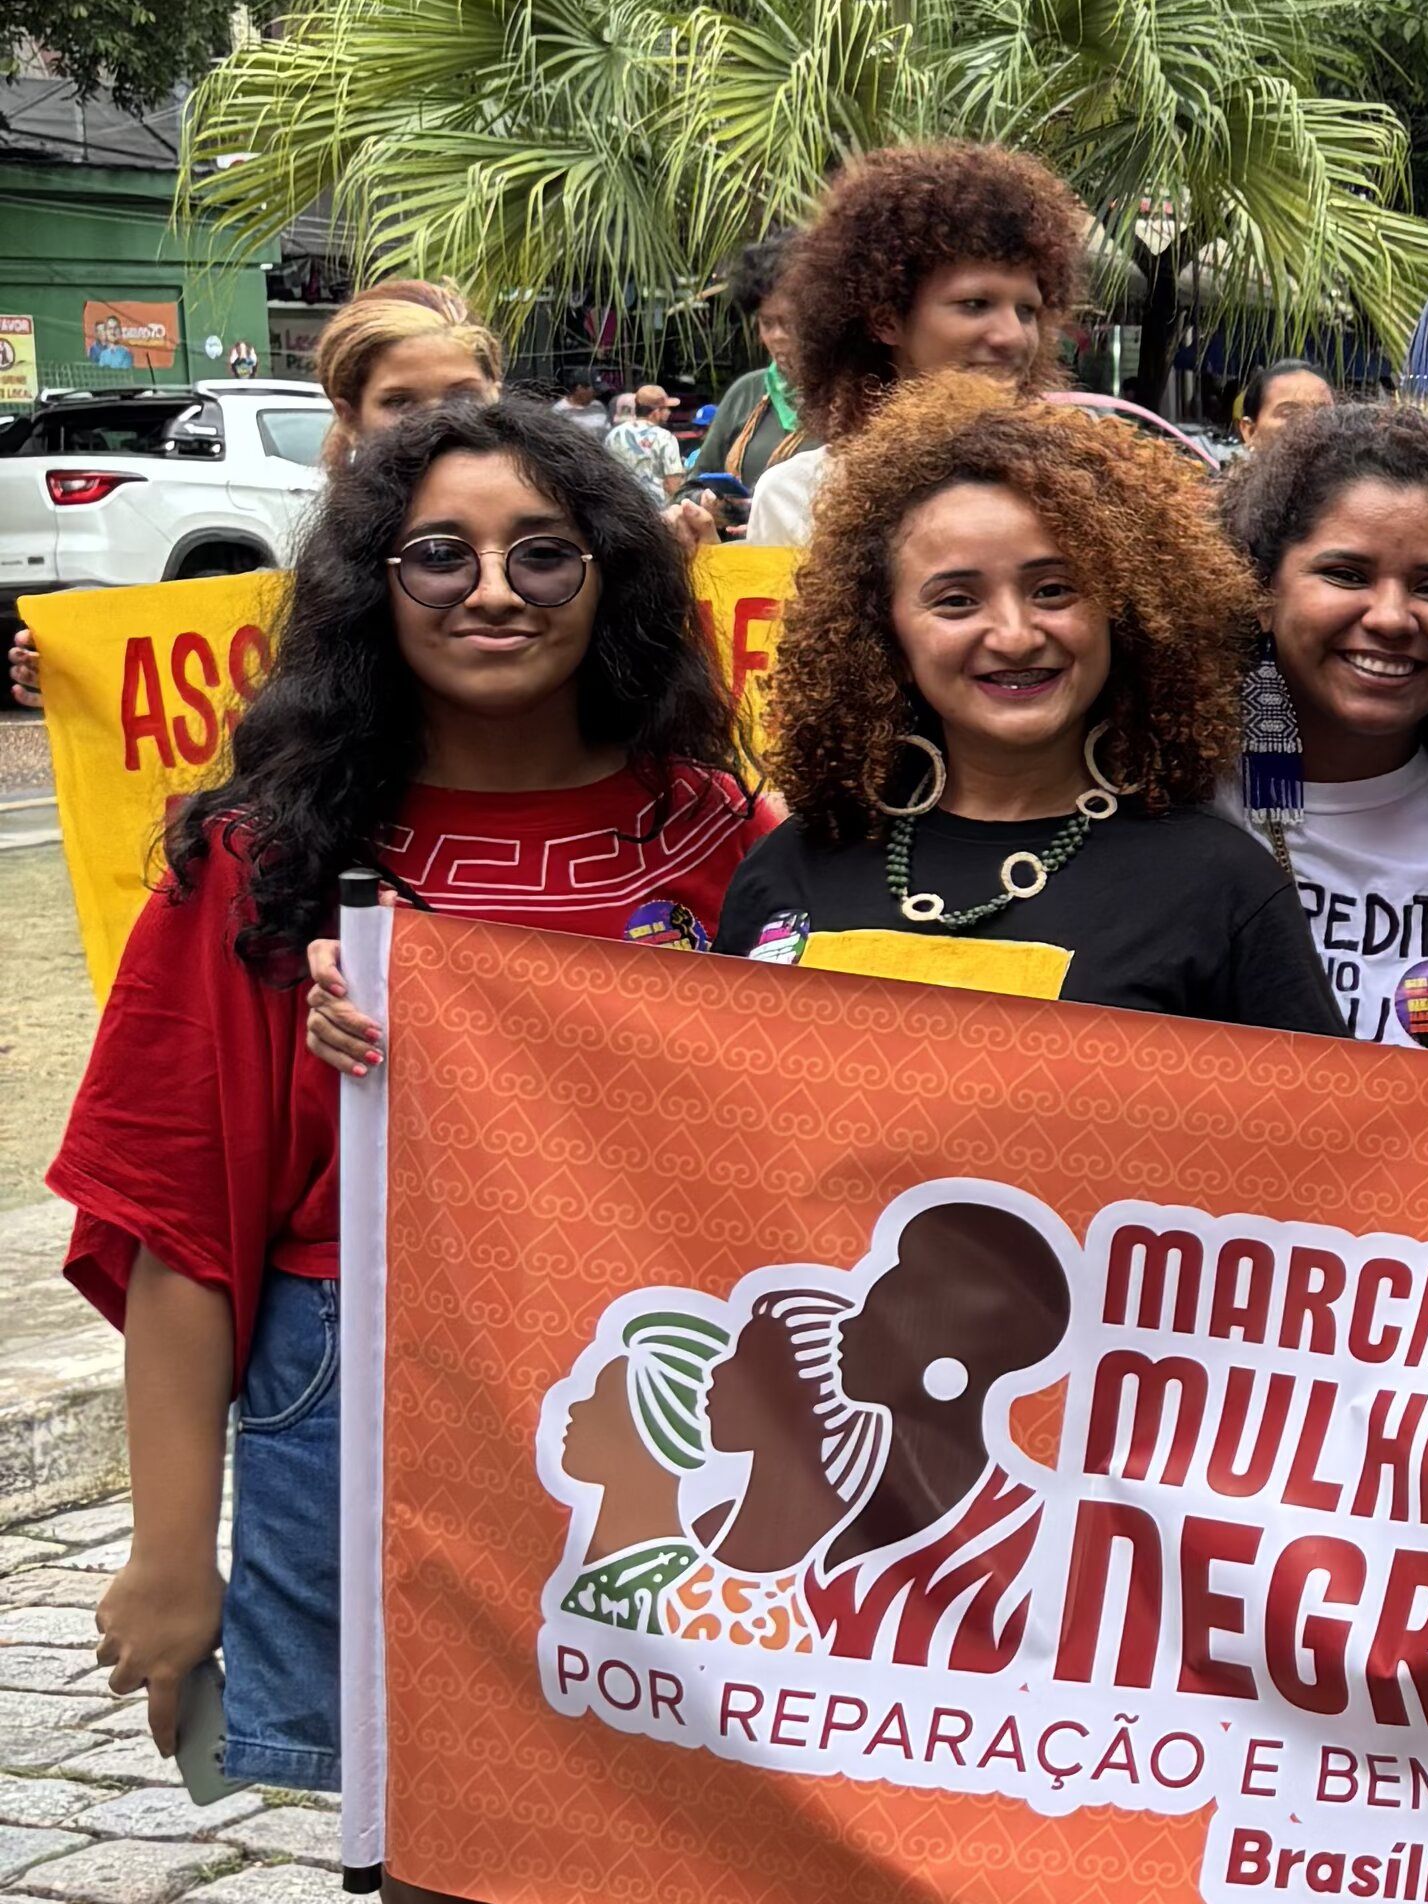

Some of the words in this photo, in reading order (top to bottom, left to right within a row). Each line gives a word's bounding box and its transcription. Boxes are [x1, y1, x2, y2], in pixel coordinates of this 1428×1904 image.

[556, 1644, 686, 1727] POR
[719, 1681, 1205, 1791] REPARAÇÃO
[1240, 1738, 1285, 1797] E
